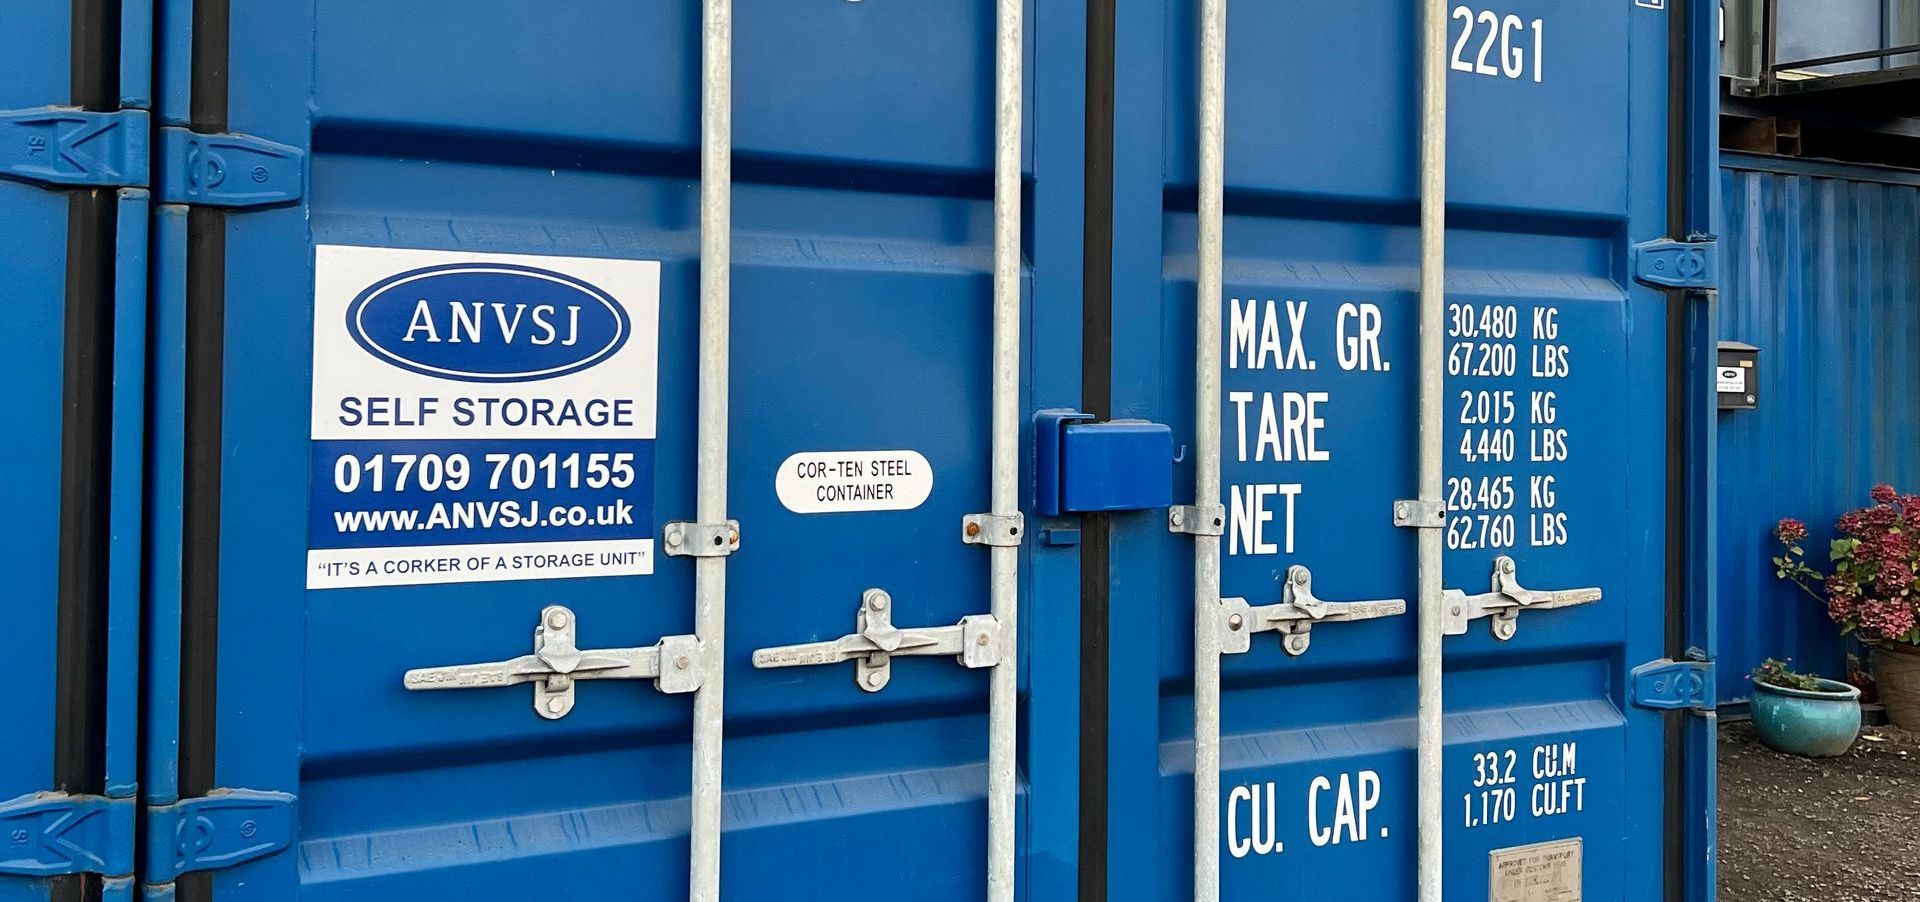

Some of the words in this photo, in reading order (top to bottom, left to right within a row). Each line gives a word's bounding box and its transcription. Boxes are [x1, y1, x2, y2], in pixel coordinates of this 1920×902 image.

[1450, 5, 1543, 83] 22G1
[402, 299, 581, 346] ANVSJ
[1229, 298, 1316, 370] MAX.
[1336, 302, 1390, 372] GR.
[1448, 303, 1517, 339] 30,480
[1533, 306, 1558, 340] KG
[1448, 342, 1516, 377] 67,200
[1532, 344, 1569, 378] LBS
[338, 396, 439, 427] SELF
[452, 397, 634, 427] STORAGE
[1460, 390, 1515, 424] 2,015
[1531, 391, 1556, 424] KG
[1229, 391, 1330, 462] TARE
[1460, 428, 1515, 463] 4,440
[1530, 428, 1568, 462] LBS
[334, 453, 470, 493] 01709
[485, 452, 635, 490] 701155
[797, 461, 863, 479] COR-TEN
[871, 459, 912, 477] STEEL
[816, 483, 894, 502] CONTAINER
[1447, 475, 1515, 511] 28,465
[1530, 475, 1555, 509] KG
[333, 499, 634, 533] www.ANVSJ.co.uk
[1229, 483, 1302, 556] NET
[1447, 513, 1515, 550] 62,760
[1530, 512, 1568, 547] LBS
[365, 561, 378, 575] A
[383, 558, 461, 574] CORKER
[467, 556, 490, 571] OF
[495, 556, 507, 570] A
[512, 553, 594, 569] STORAGE
[1473, 749, 1517, 788] 33.2
[1532, 742, 1576, 778] CU.M
[1227, 782, 1284, 858] CU.
[1308, 770, 1389, 847] CAP.
[1464, 788, 1516, 828] 1,170
[1531, 778, 1586, 817] CU.FT
